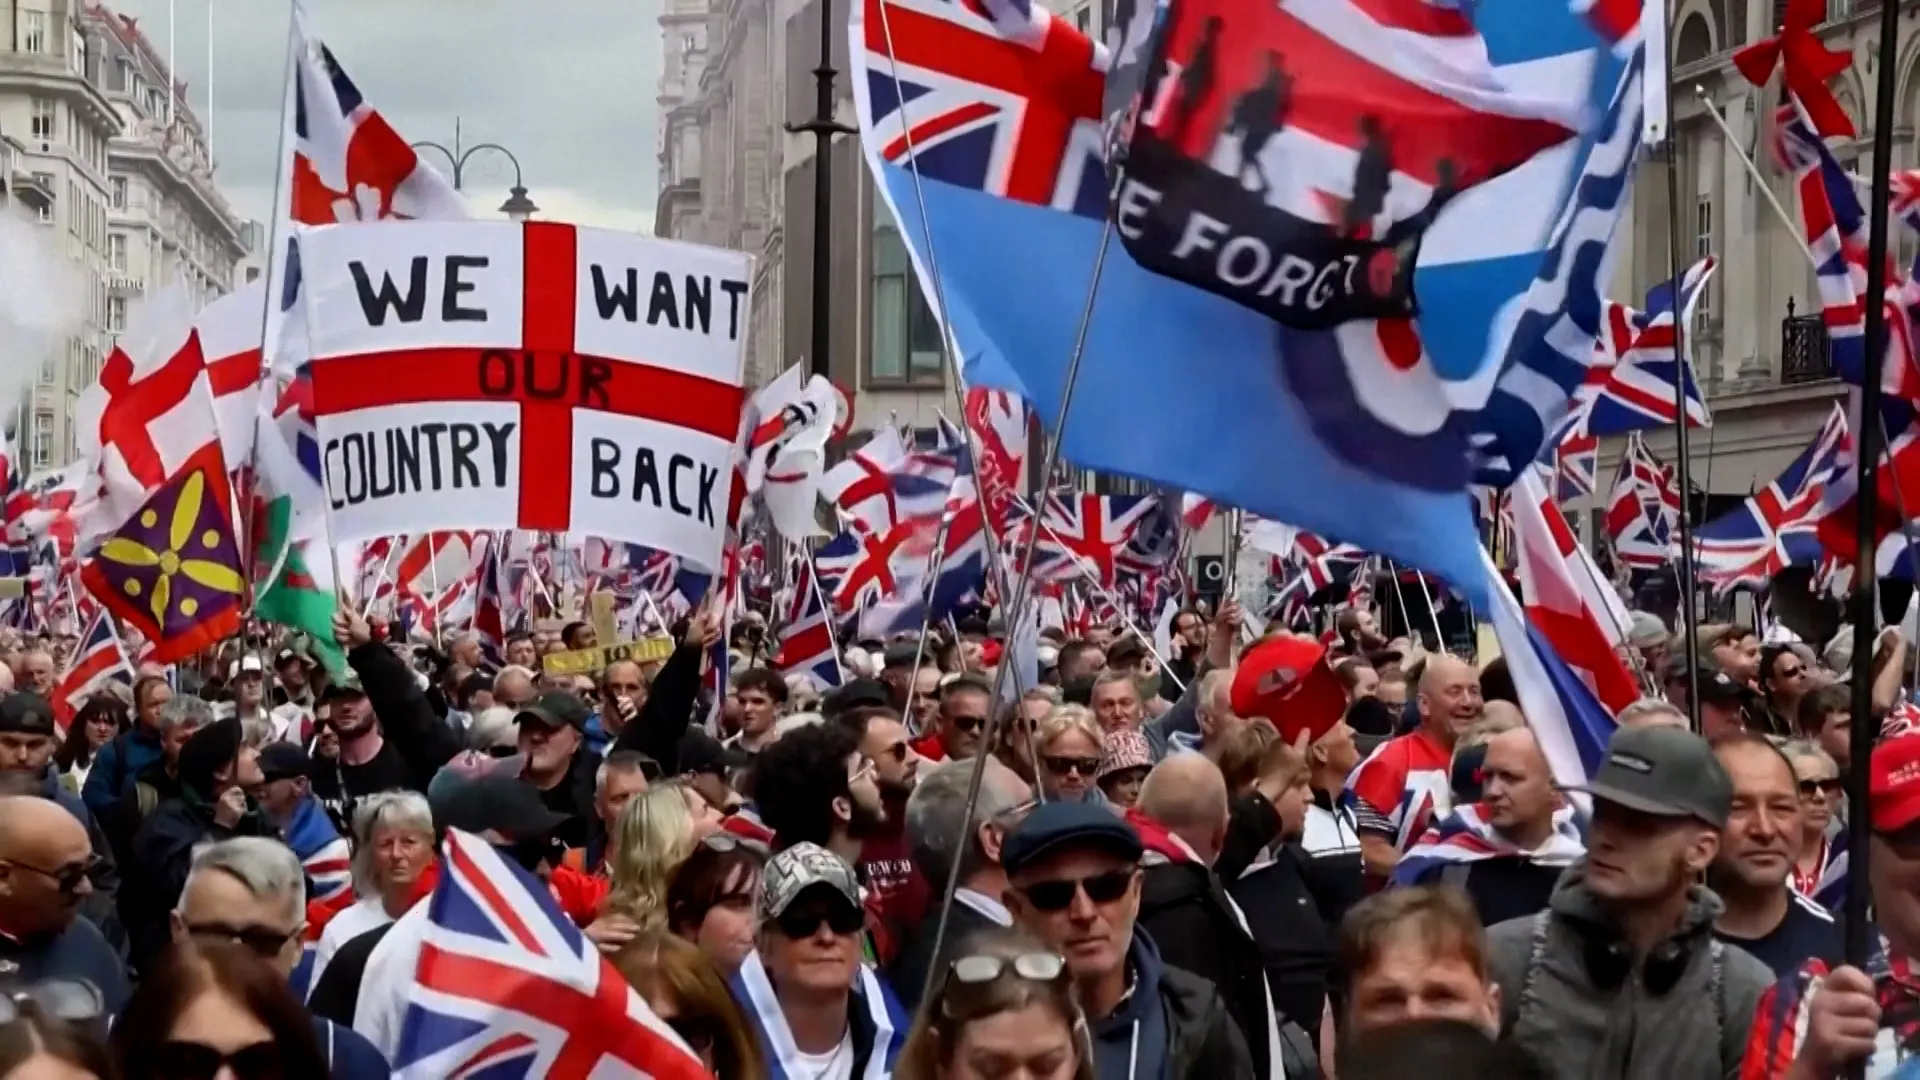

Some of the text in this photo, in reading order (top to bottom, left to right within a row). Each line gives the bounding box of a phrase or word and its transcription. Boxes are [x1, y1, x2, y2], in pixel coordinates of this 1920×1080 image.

[348, 255, 749, 341] WE WANT
[477, 348, 613, 408] OUR
[324, 421, 718, 529] COUNTRY BACK
